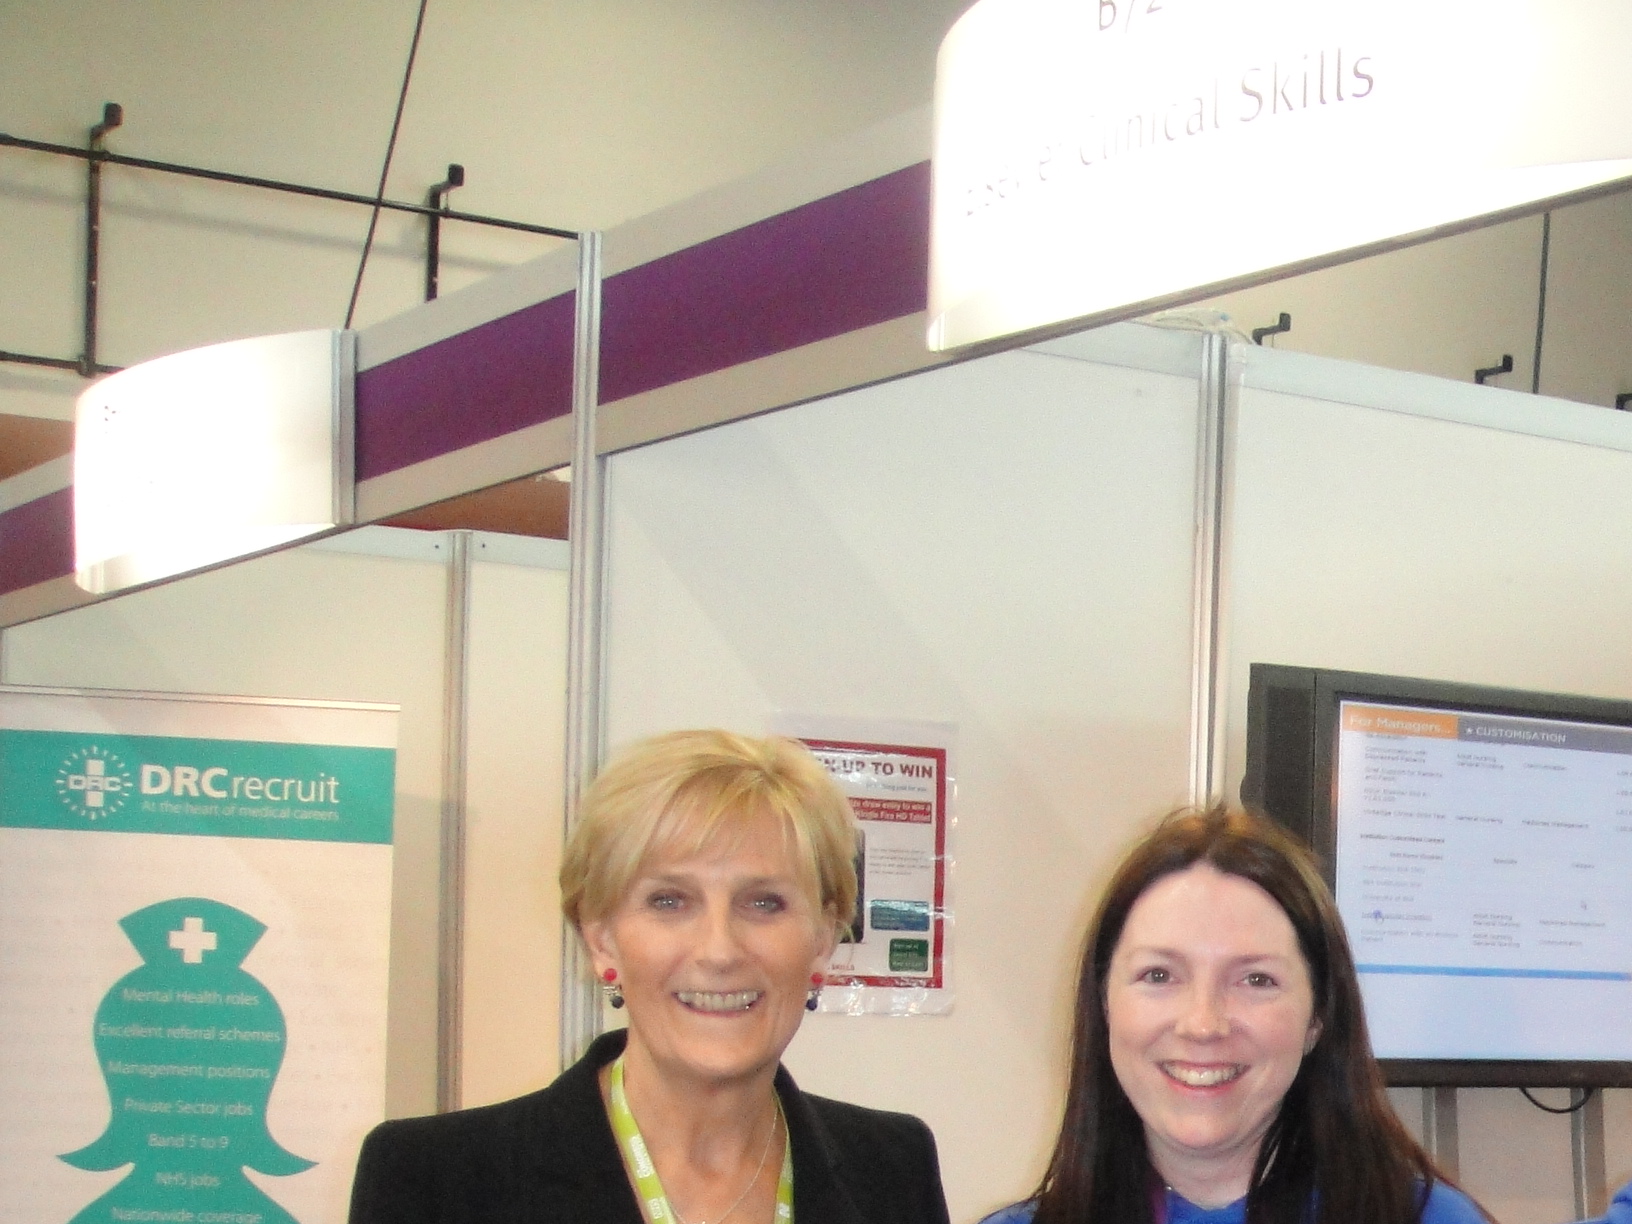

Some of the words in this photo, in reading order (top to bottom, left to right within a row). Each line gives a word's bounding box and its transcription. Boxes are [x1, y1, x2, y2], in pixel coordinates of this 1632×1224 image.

[1239, 46, 1374, 122] Skills
[1476, 726, 1568, 743] CUSTOMISATION
[871, 761, 894, 776] TO
[899, 763, 933, 779] WIN
[219, 1027, 281, 1042] schemes
[108, 1060, 203, 1079] Management
[224, 1101, 253, 1117] jobs
[156, 1172, 187, 1186] NHS
[112, 1206, 194, 1222] Nationwide
